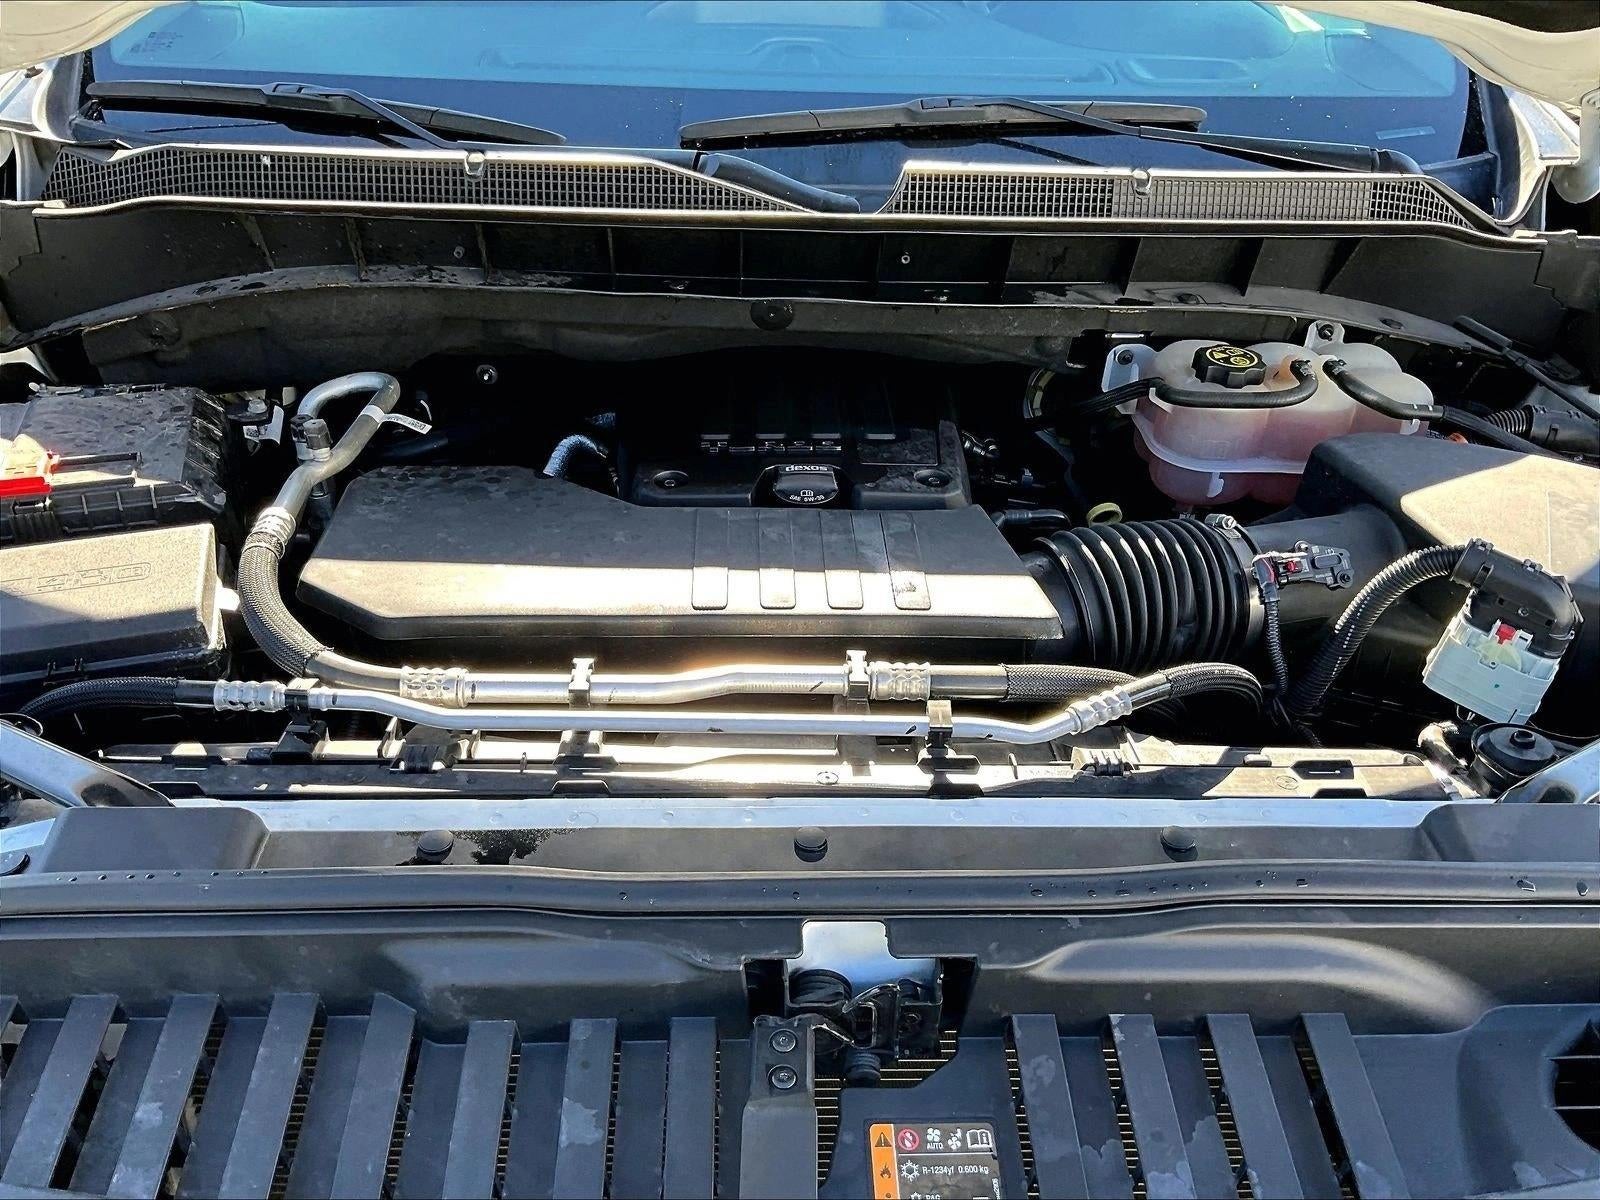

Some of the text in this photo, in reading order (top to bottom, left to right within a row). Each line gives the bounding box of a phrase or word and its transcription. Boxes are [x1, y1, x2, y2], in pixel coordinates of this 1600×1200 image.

[926, 1142, 944, 1150] AUTO
[922, 1164, 989, 1176] R-1234yf 0.600 kg
